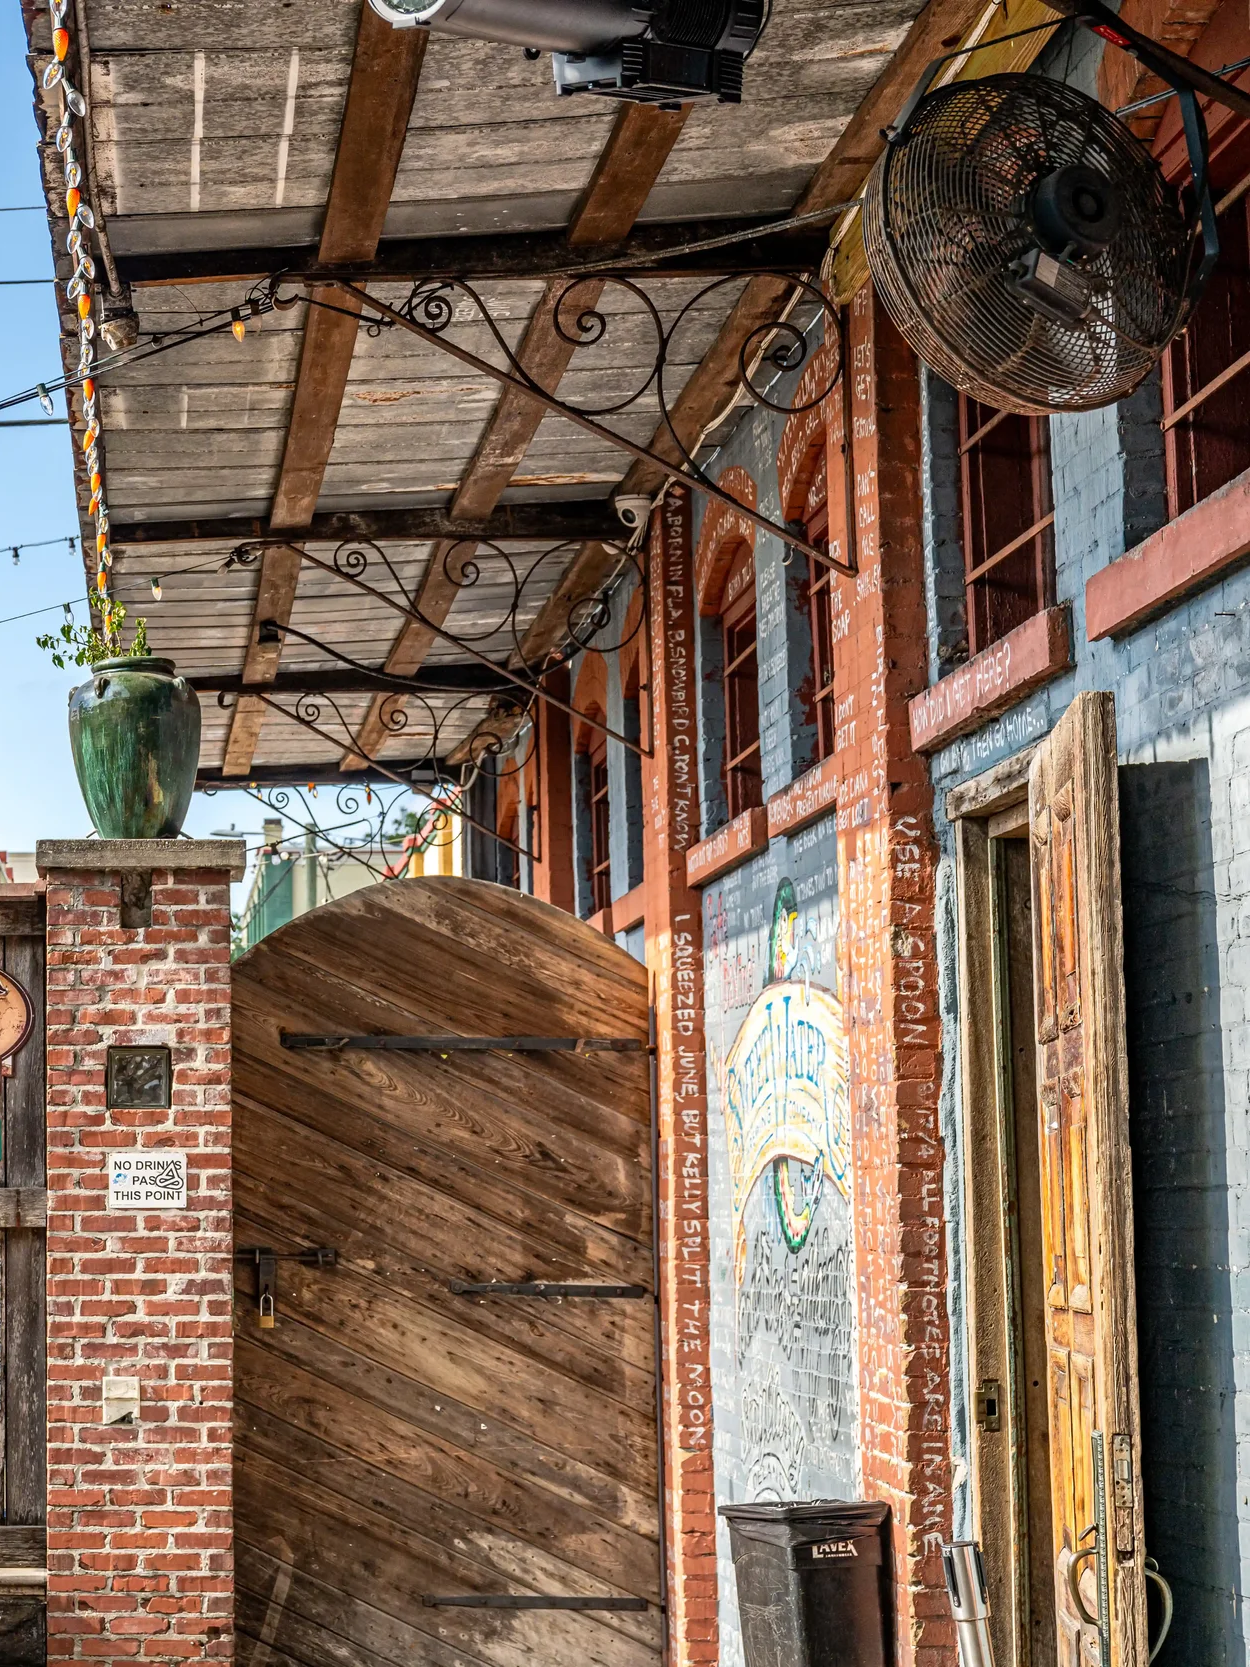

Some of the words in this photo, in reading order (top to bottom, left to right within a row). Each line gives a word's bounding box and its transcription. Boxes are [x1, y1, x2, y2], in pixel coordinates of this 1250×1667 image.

[680, 1109, 702, 1147] BUT
[114, 1161, 132, 1170] NO
[136, 1161, 182, 1170] DRINS
[681, 1153, 704, 1212] KELLY
[114, 1191, 141, 1200] THIS
[145, 1191, 182, 1200] POINT
[680, 1220, 703, 1287] SPLIT
[681, 1300, 703, 1352] THE
[684, 1364, 707, 1446] MOON
[812, 1540, 859, 1559] LAVEX
